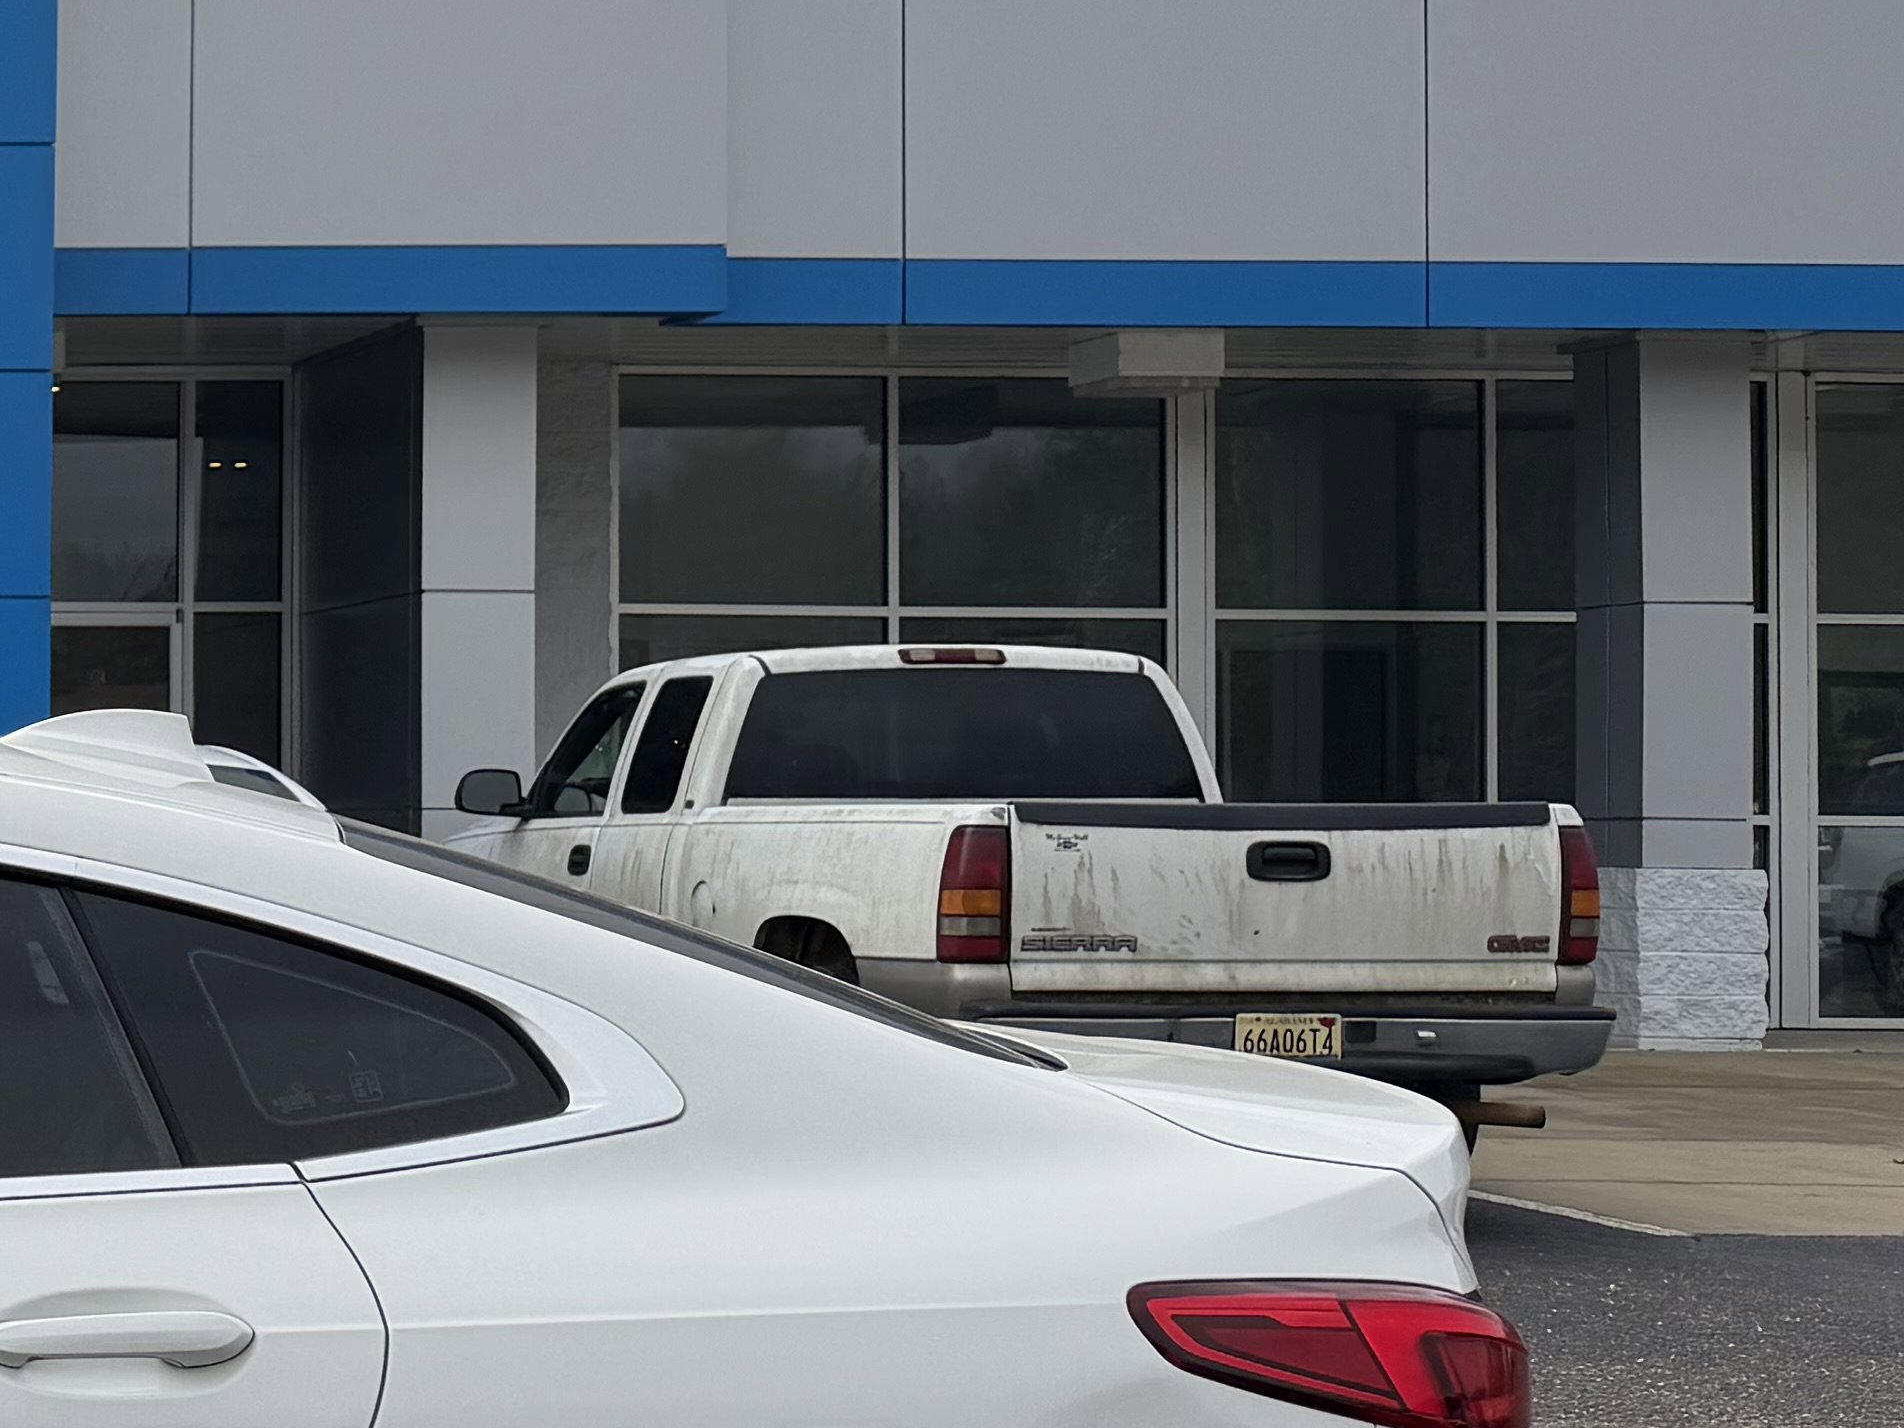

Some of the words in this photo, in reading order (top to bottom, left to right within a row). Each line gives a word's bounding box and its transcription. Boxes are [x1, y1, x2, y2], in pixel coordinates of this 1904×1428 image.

[1021, 934, 1138, 954] SIERRA
[1487, 934, 1551, 953] GMC
[1243, 1028, 1334, 1054] 66A06T4
